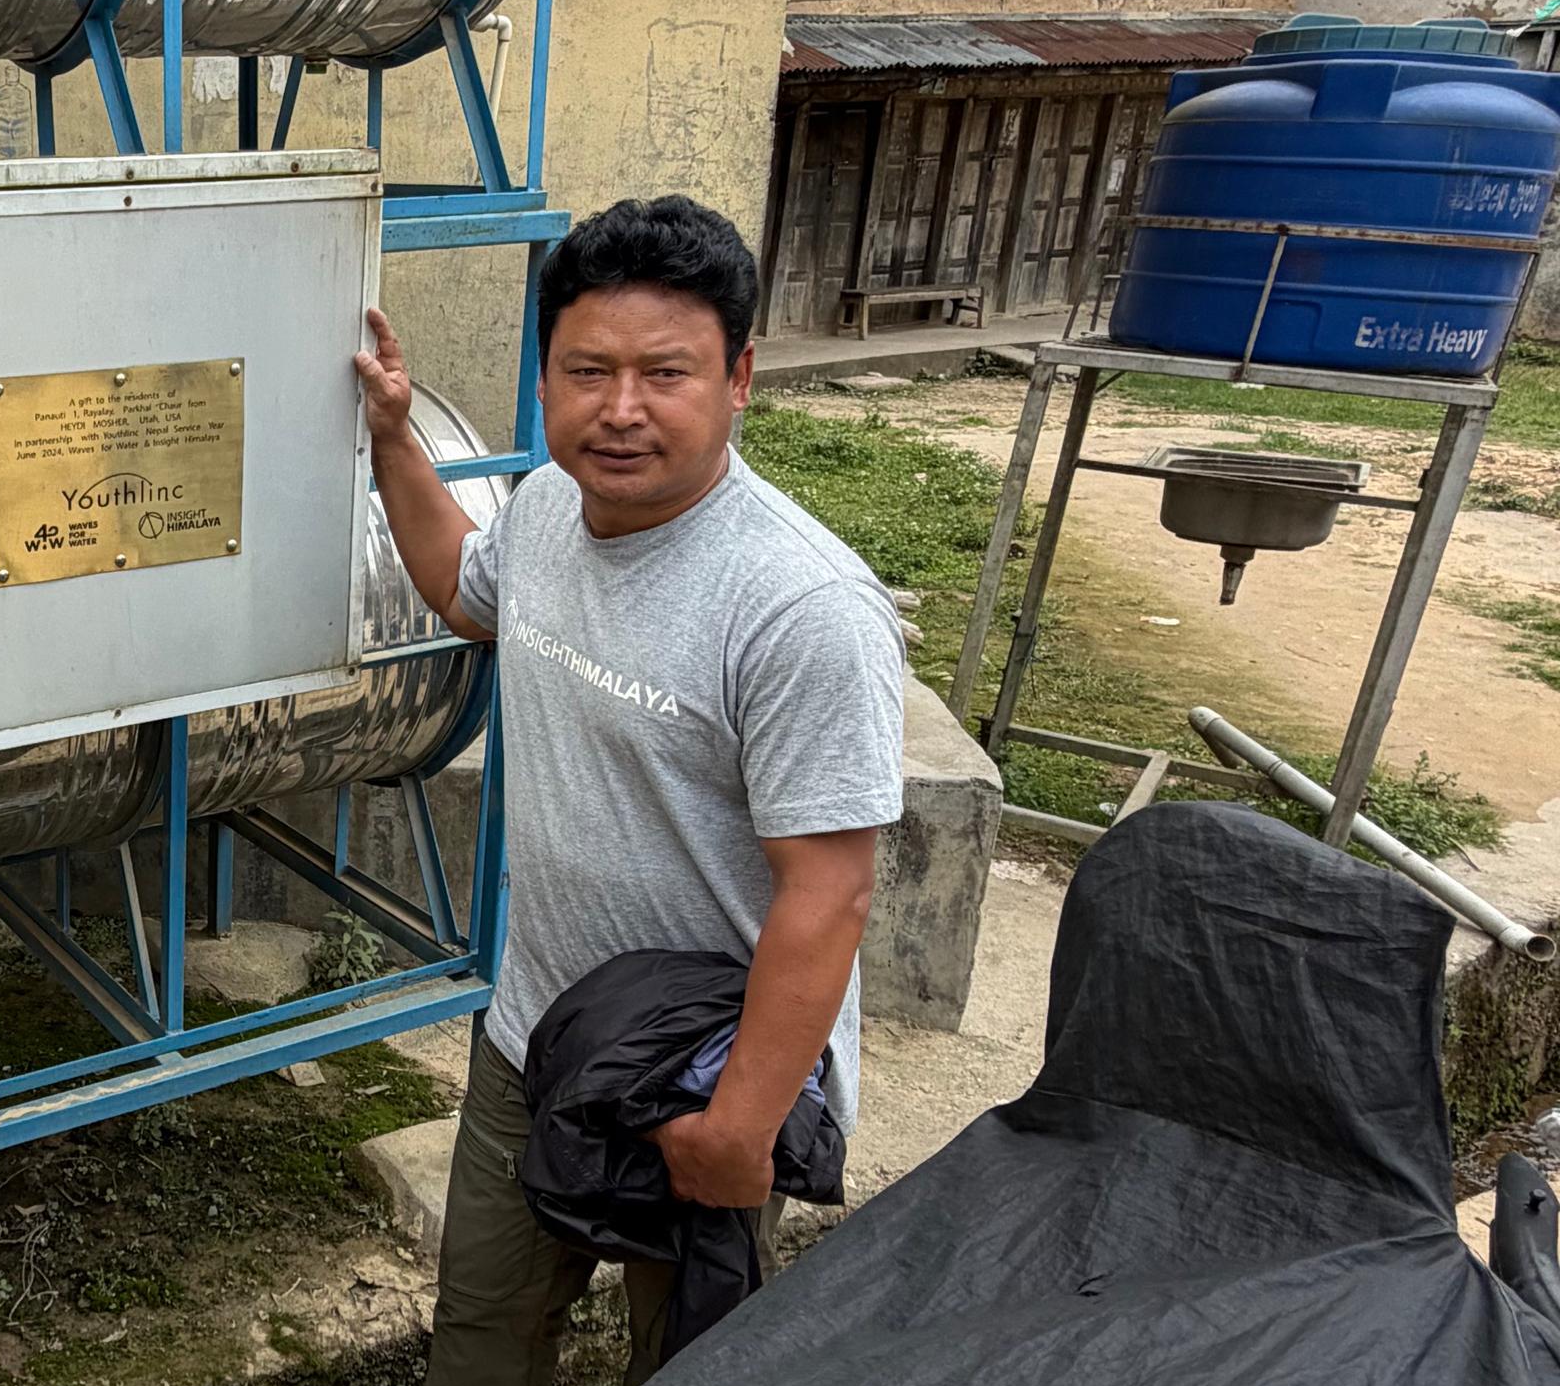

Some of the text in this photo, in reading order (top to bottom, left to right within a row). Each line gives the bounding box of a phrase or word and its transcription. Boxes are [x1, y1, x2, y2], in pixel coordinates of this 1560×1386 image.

[1354, 316, 1489, 360] Extra Heavy
[78, 396, 92, 408] gift
[96, 396, 105, 404] to
[108, 394, 121, 404] the
[124, 391, 160, 402] residents
[167, 389, 176, 399] of
[34, 412, 66, 422] Panauti
[187, 399, 207, 408] from
[60, 421, 86, 431] HEYDI
[165, 413, 182, 422] USA
[14, 439, 23, 448] In
[25, 435, 73, 448] partnership
[81, 432, 100, 441] with
[146, 425, 169, 436] Nepal
[173, 424, 201, 433] Service
[208, 421, 225, 430] Year
[16, 451, 36, 461] June
[41, 447, 65, 458] 2024,
[68, 445, 95, 455] Waves
[101, 443, 113, 452] for
[115, 441, 139, 450] Water
[153, 436, 180, 448] Insight
[184, 433, 220, 444] Himalaya
[62, 479, 184, 511] Youthlinc
[166, 508, 207, 521] INSIGHT
[68, 520, 99, 531] WAVES
[166, 516, 221, 533] HIMALAYA
[68, 530, 86, 539] FOR
[68, 537, 97, 549] WATER
